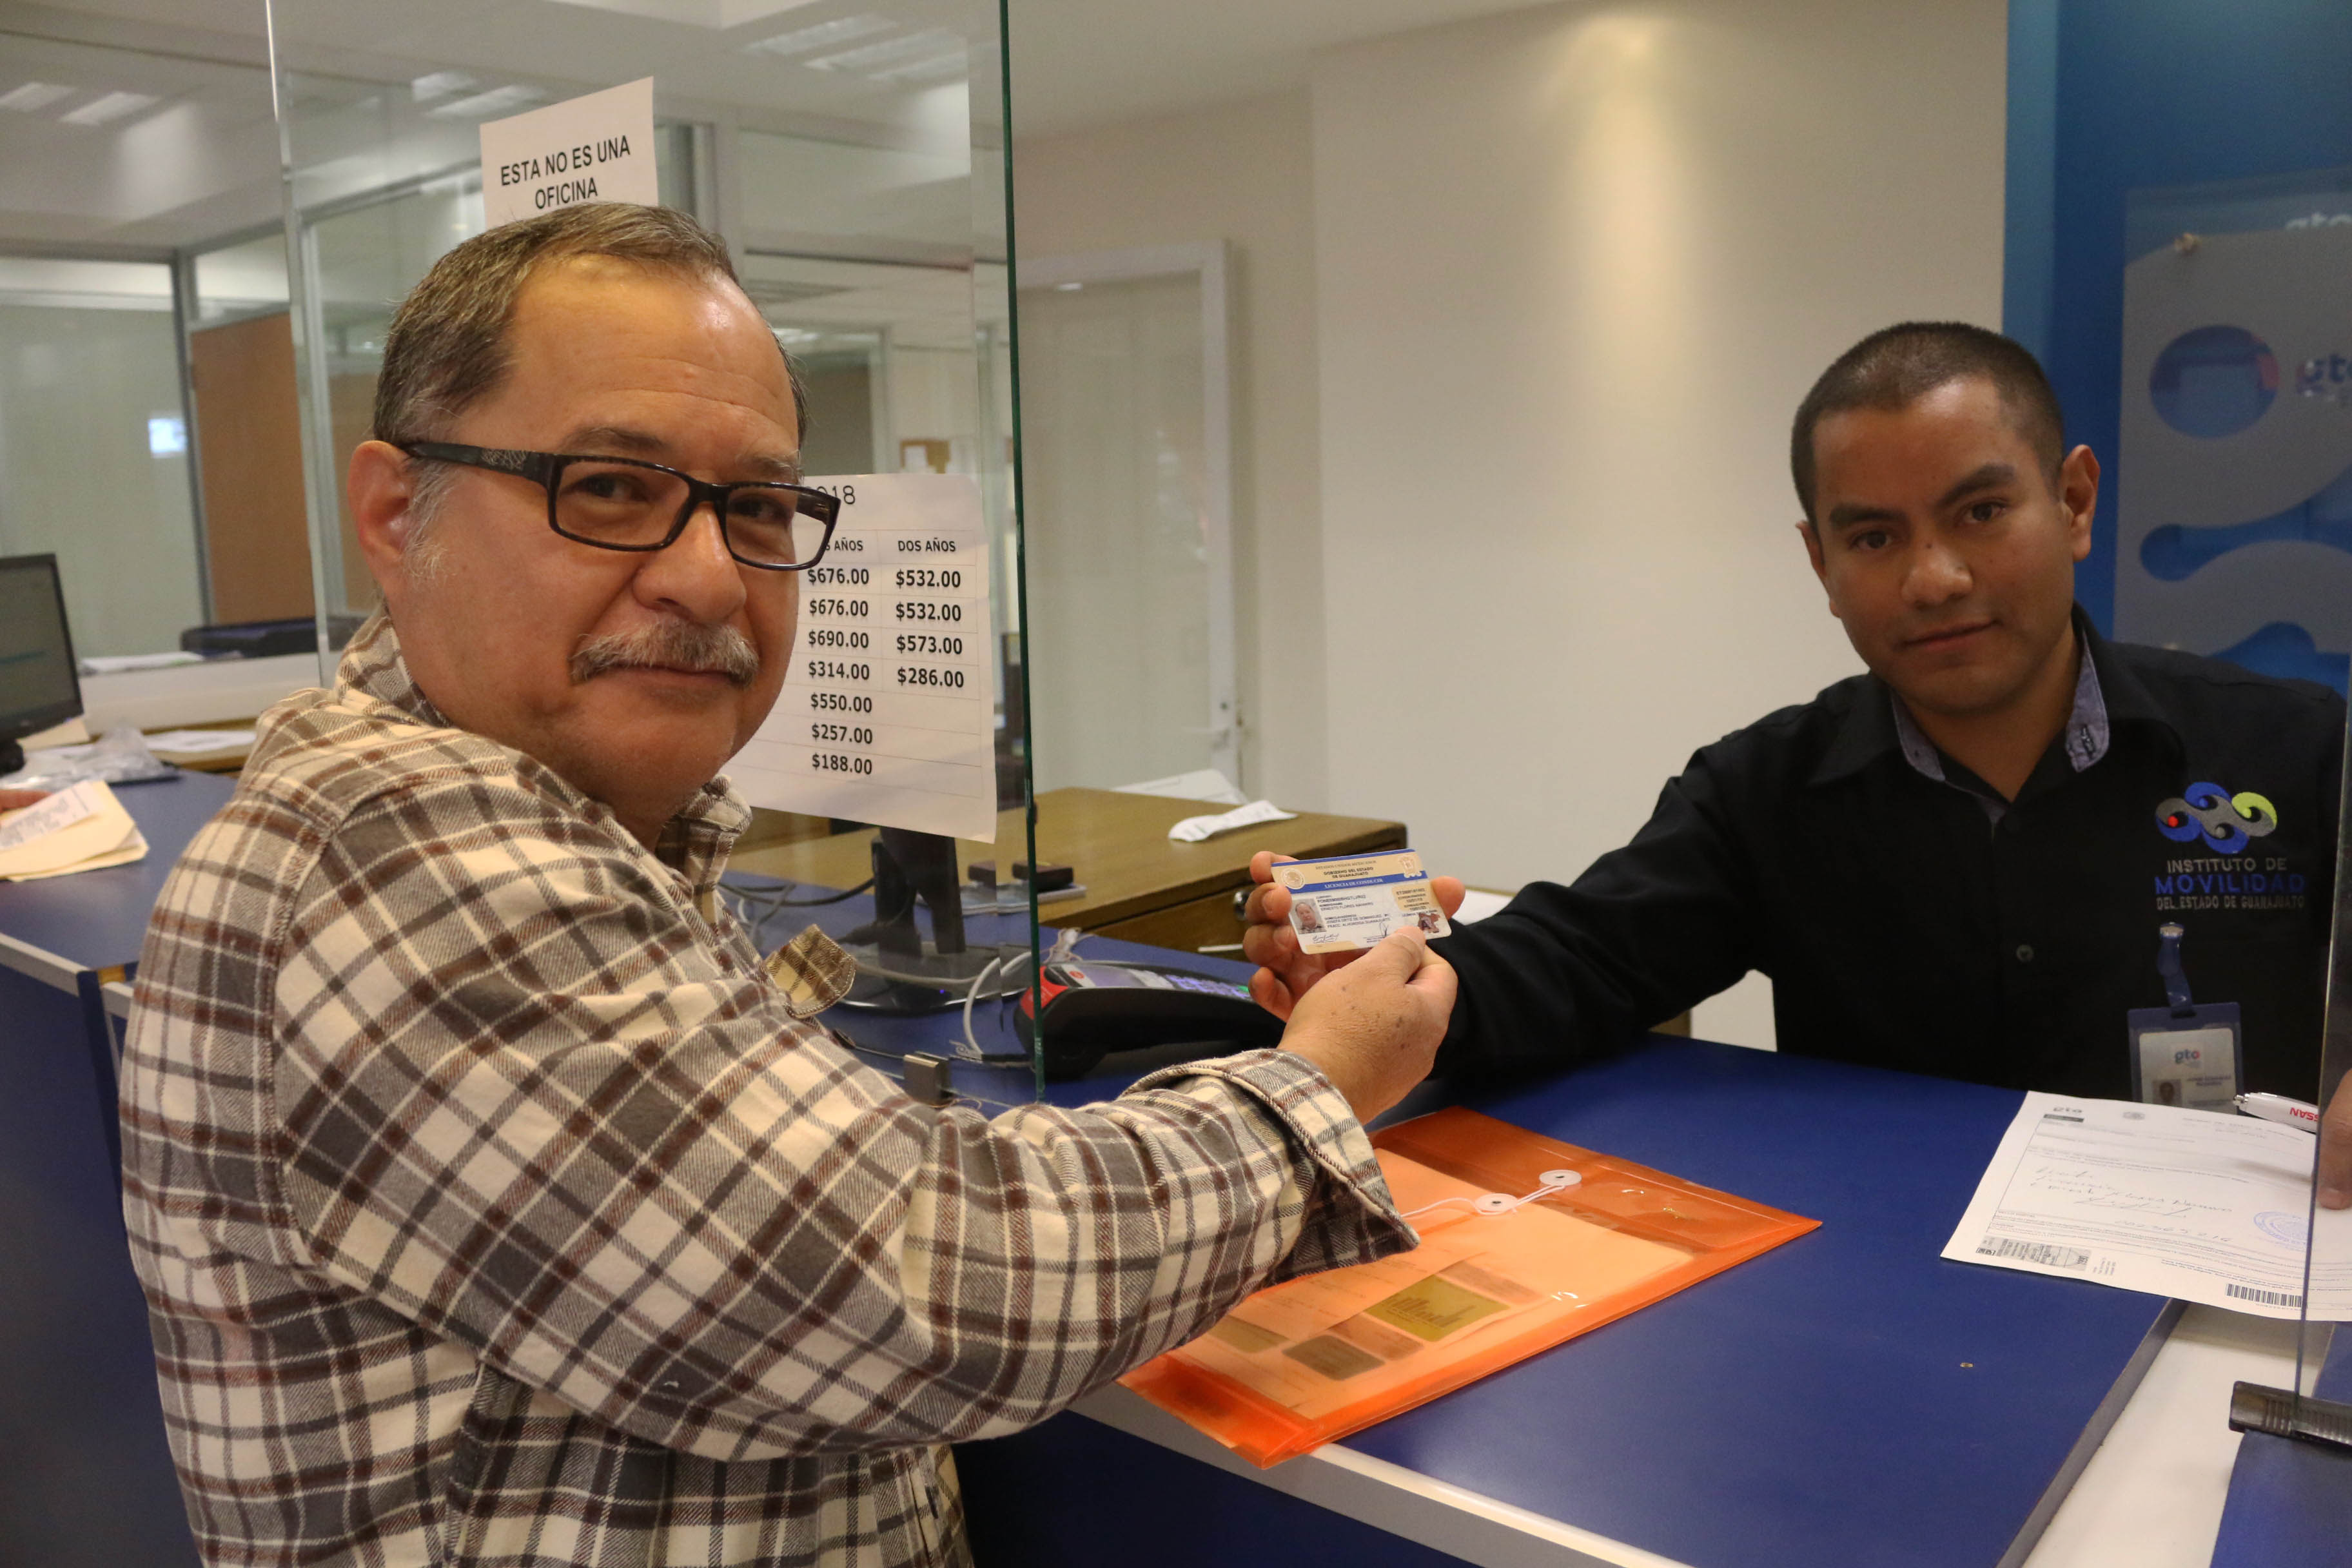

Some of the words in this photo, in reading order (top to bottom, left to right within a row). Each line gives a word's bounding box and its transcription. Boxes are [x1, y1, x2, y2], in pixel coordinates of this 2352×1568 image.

[500, 159, 540, 186] ESTA
[545, 152, 567, 176] NO
[573, 144, 592, 170] ES
[597, 135, 631, 162] UNA
[535, 177, 598, 209] OFICINA
[834, 537, 863, 552] AÑOS
[897, 540, 922, 553] DOS
[925, 538, 956, 553] AÑOS
[807, 569, 870, 585] $676.00
[896, 570, 961, 588] $532.00
[809, 600, 868, 617] $676.00
[896, 602, 961, 622] $532.00
[808, 630, 869, 649] $690.00
[896, 635, 963, 655] $573.00
[808, 661, 870, 680] $314.00
[897, 667, 965, 688] $286.00
[810, 692, 872, 713] $550.00
[811, 723, 873, 745] $257.00
[812, 754, 872, 775] $188.00
[2167, 858, 2256, 873] INSTITUTO
[2266, 858, 2287, 870] DE
[2155, 873, 2306, 894] MOVILIDAD
[2157, 897, 2176, 910] DEL
[2180, 896, 2219, 909] ESTADO
[2224, 895, 2237, 908] DE
